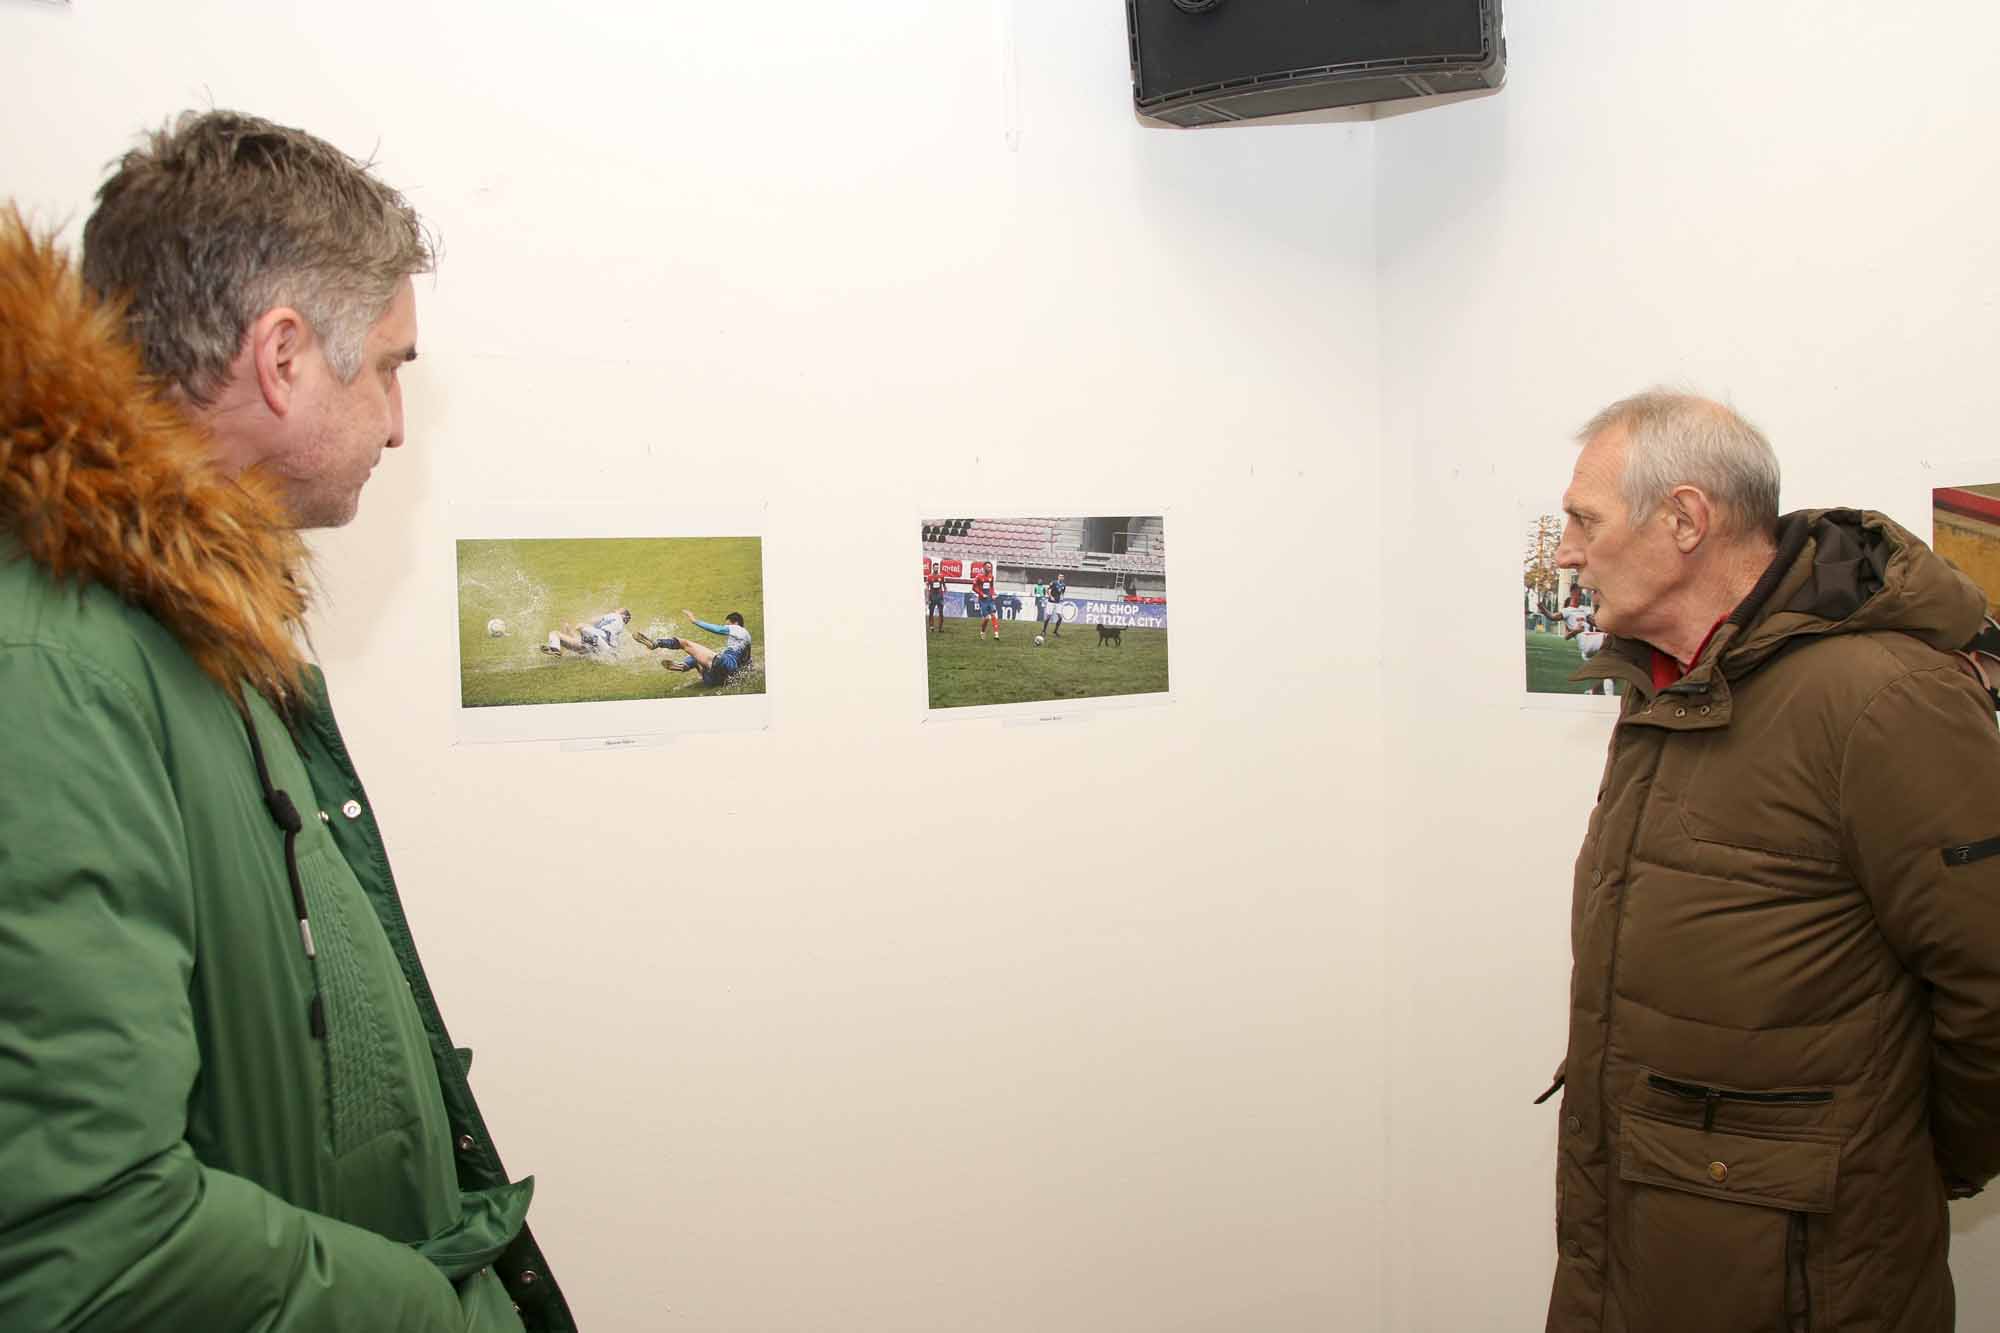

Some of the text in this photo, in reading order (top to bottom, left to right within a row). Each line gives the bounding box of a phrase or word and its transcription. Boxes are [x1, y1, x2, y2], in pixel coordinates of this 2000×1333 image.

[1086, 601, 1139, 616] FAN SHOP
[1086, 613, 1162, 628] FK TUZLA CITY
